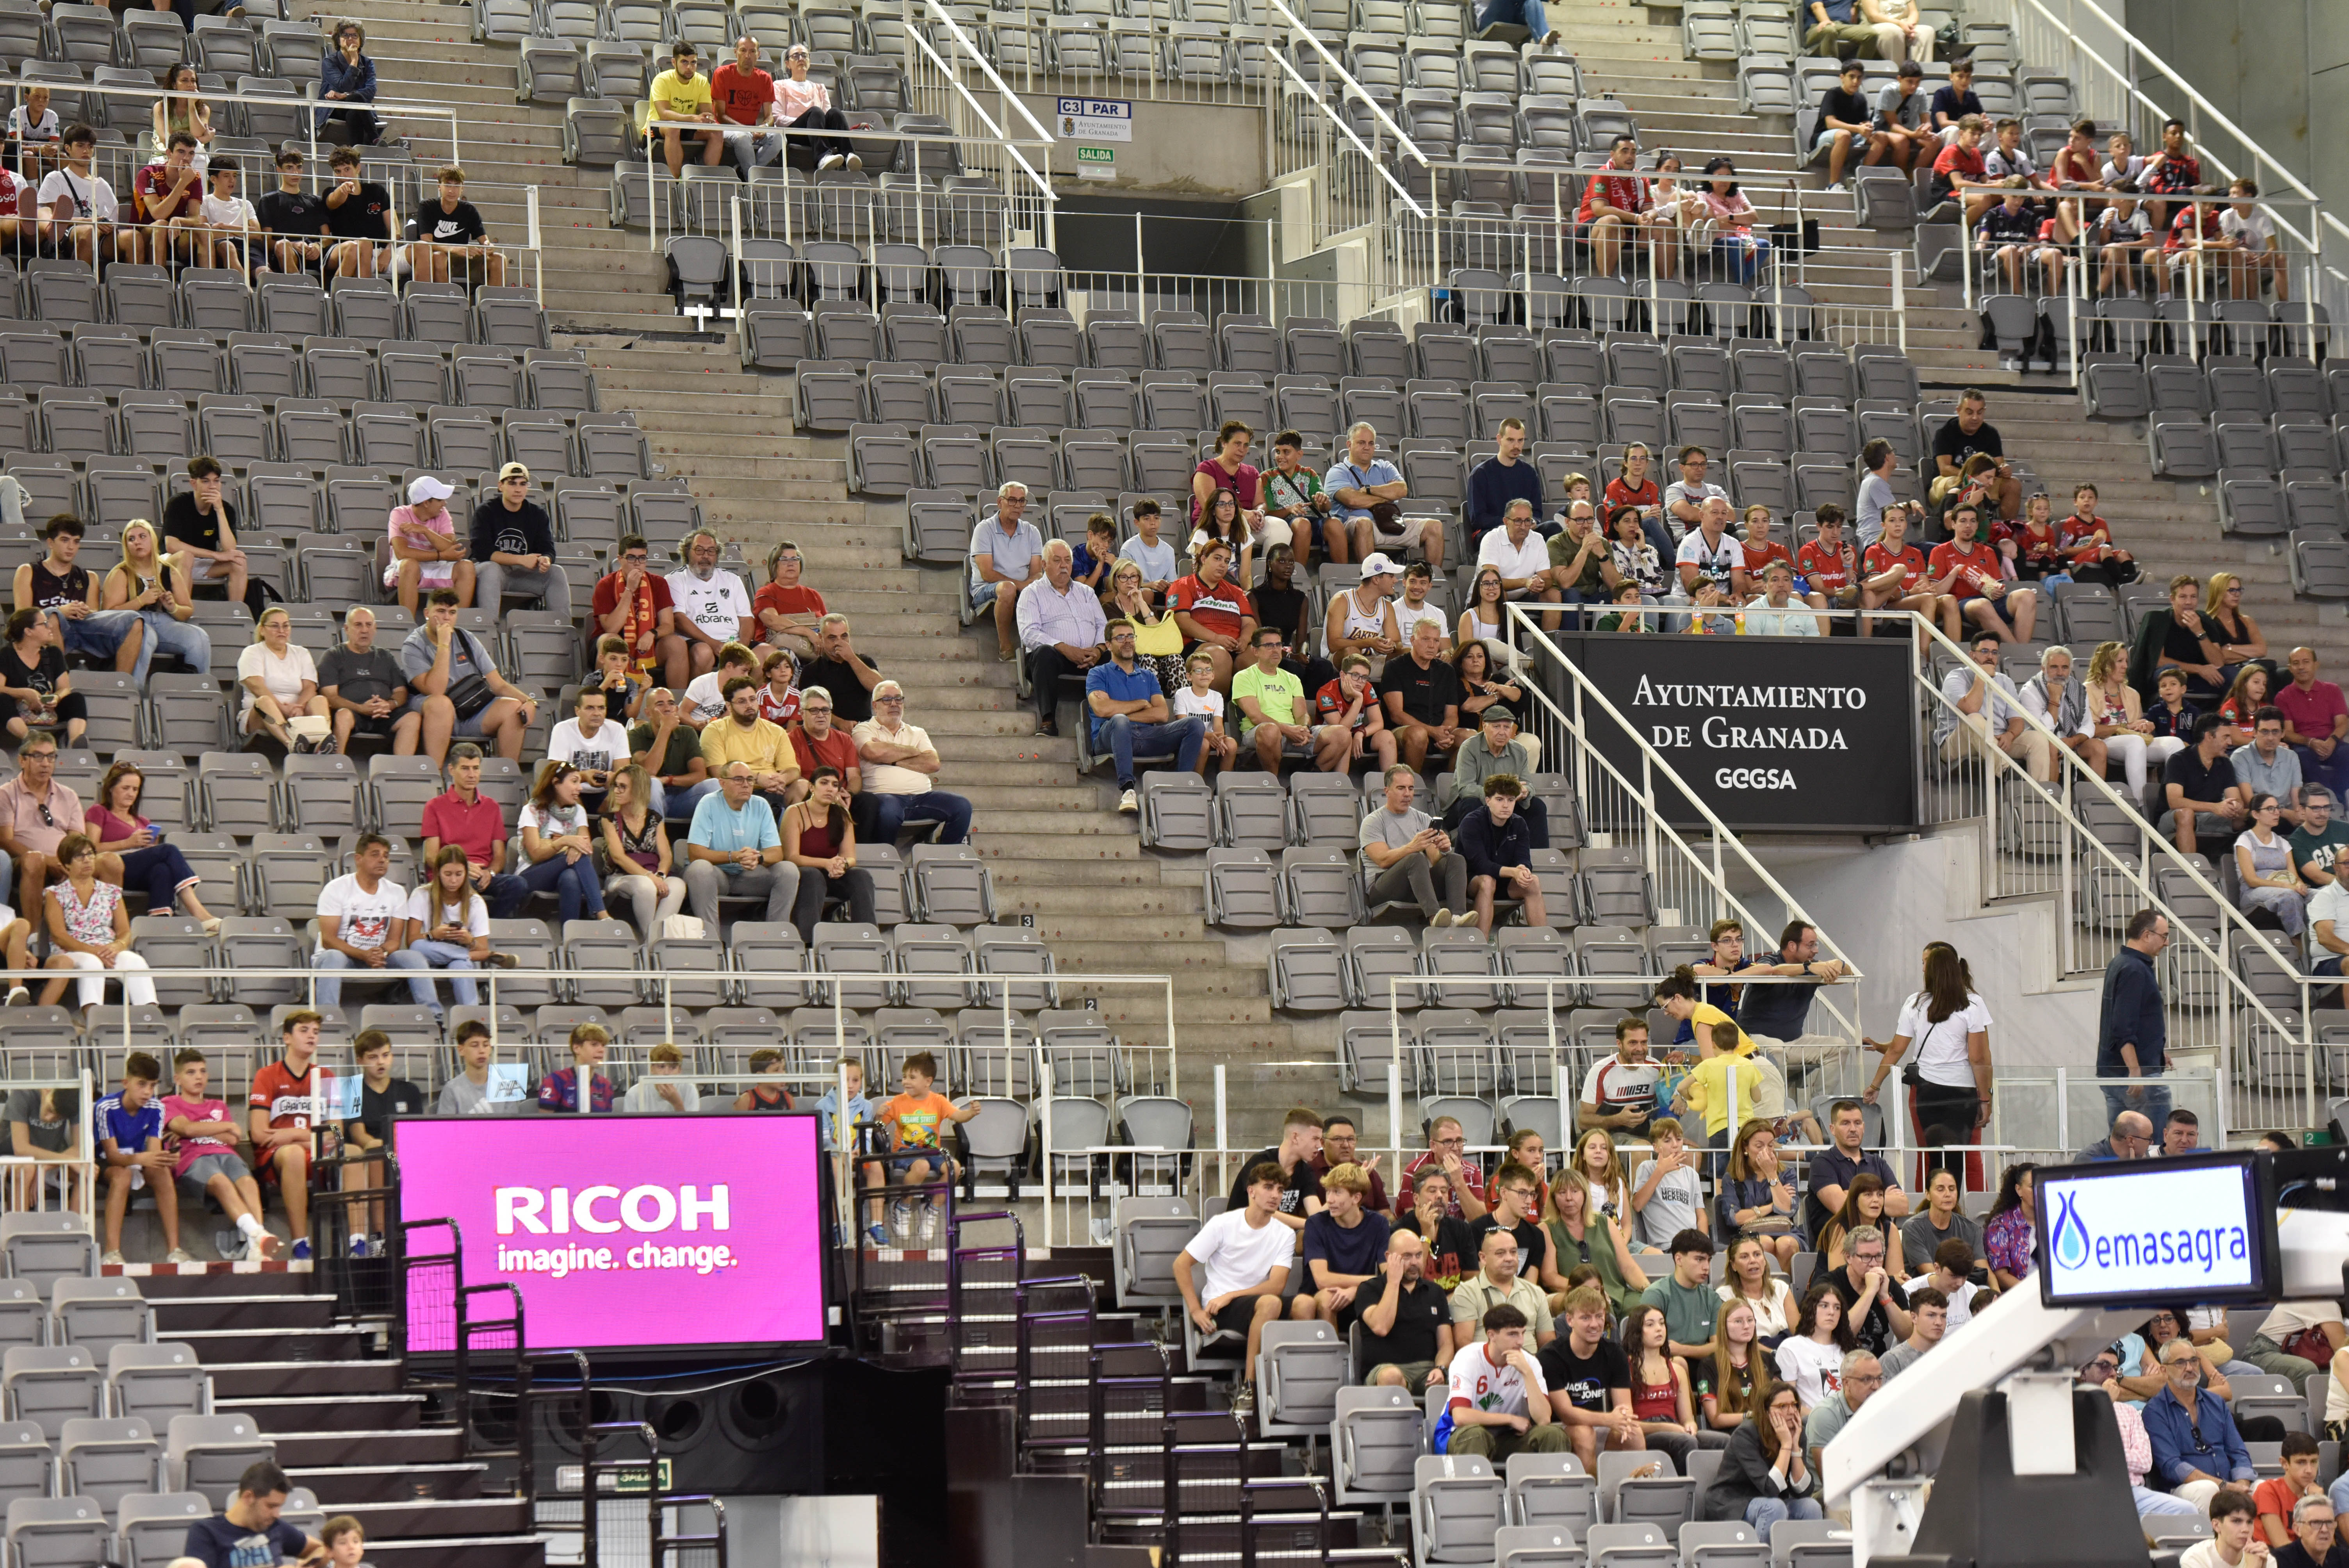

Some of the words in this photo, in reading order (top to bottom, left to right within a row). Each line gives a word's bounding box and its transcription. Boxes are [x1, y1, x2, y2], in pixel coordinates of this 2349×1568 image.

[1063, 102, 1079, 112] C3
[1093, 103, 1118, 115] PAR
[1078, 121, 1126, 130] AYUNTAMIENTO
[1089, 128, 1118, 137] GRANADA
[403, 140, 409, 148] 2
[1080, 149, 1111, 160] SALIDA
[438, 220, 458, 233] NIKE
[695, 615, 733, 625] fibranet
[1633, 674, 1866, 709] AYUNTAMIENTO
[2180, 713, 2193, 730] N
[1702, 716, 1848, 750] GRANADA
[1025, 916, 1031, 927] 3
[1155, 1085, 1160, 1095] 1
[1635, 1084, 1650, 1095] 93
[2307, 1133, 2314, 1144] 2
[495, 1185, 730, 1234] RICOH
[2096, 1226, 2246, 1273] emasagra
[498, 1243, 620, 1278] imagine.
[627, 1241, 738, 1275] change.
[1477, 1376, 1487, 1394] 6
[1565, 1381, 1589, 1392] JACK&
[1581, 1388, 1605, 1399] JONES
[620, 1468, 666, 1482] SALIA
